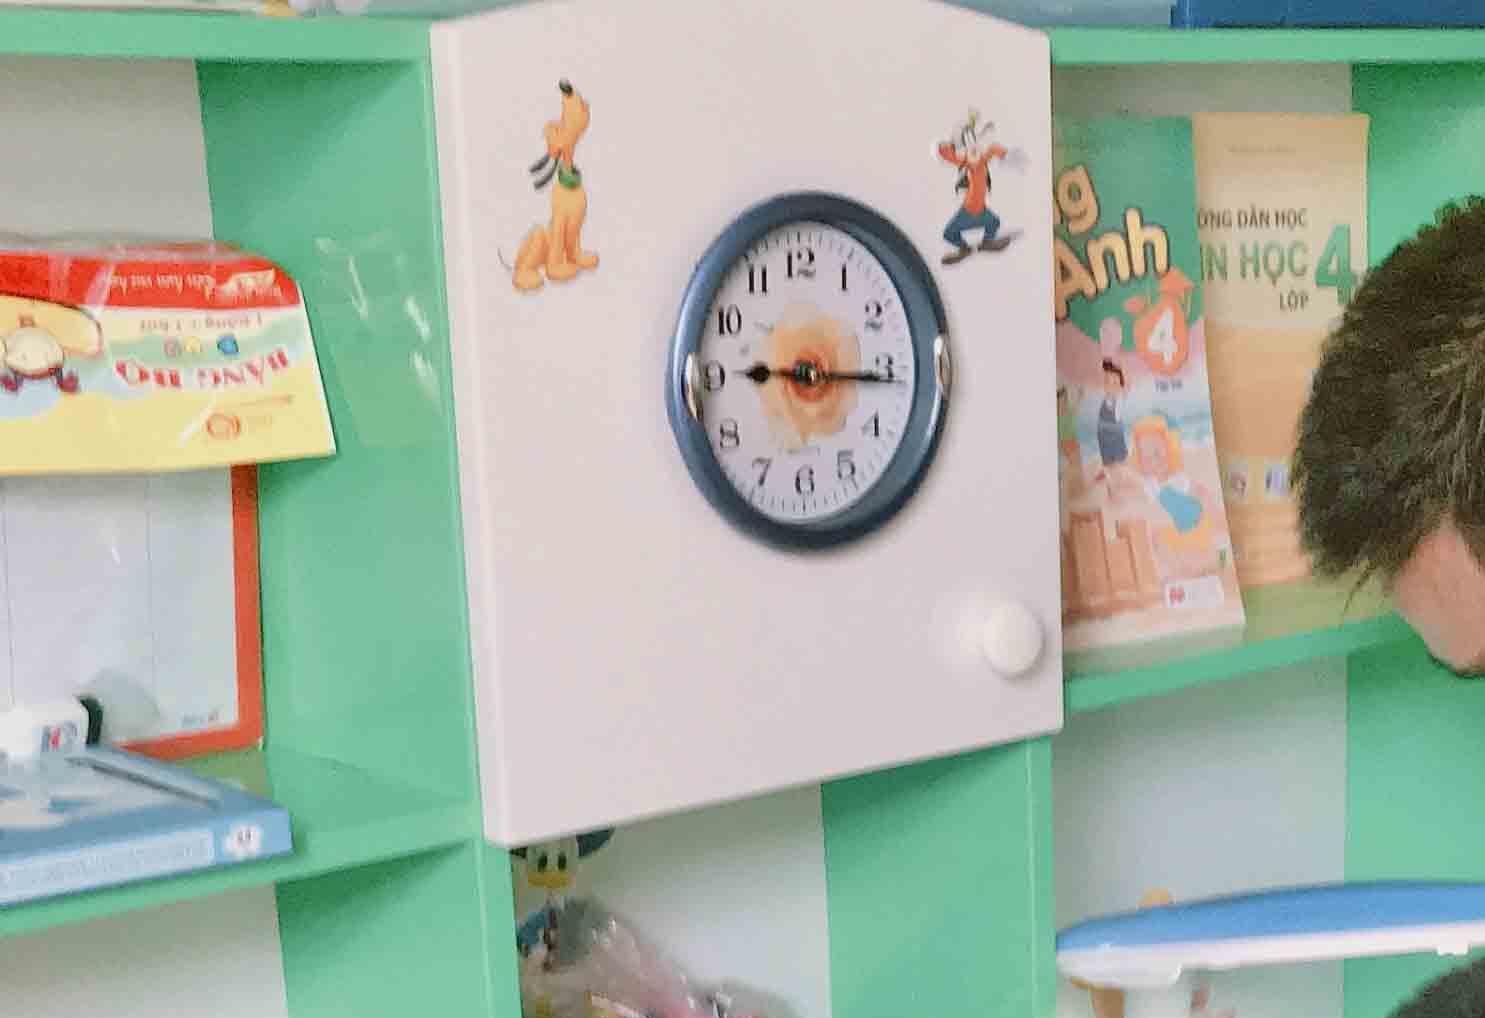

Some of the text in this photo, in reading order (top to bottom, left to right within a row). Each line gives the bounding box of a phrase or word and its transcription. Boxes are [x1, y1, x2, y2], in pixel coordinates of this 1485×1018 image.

[1274, 207, 1308, 230] HỌC
[786, 247, 816, 279] 12
[841, 264, 848, 292] 1
[1055, 207, 1169, 321] Anh
[1239, 239, 1308, 287] HỌC
[1314, 223, 1359, 305] 4
[749, 264, 767, 294] 11
[717, 303, 742, 336] 10
[864, 301, 883, 332] 2
[1147, 306, 1178, 365] 4
[704, 360, 725, 392] 9
[875, 353, 896, 382] 3
[719, 418, 741, 449] 8
[861, 411, 882, 438] 4
[752, 456, 772, 486] 7
[795, 464, 816, 496] 6
[836, 450, 857, 481] 5
